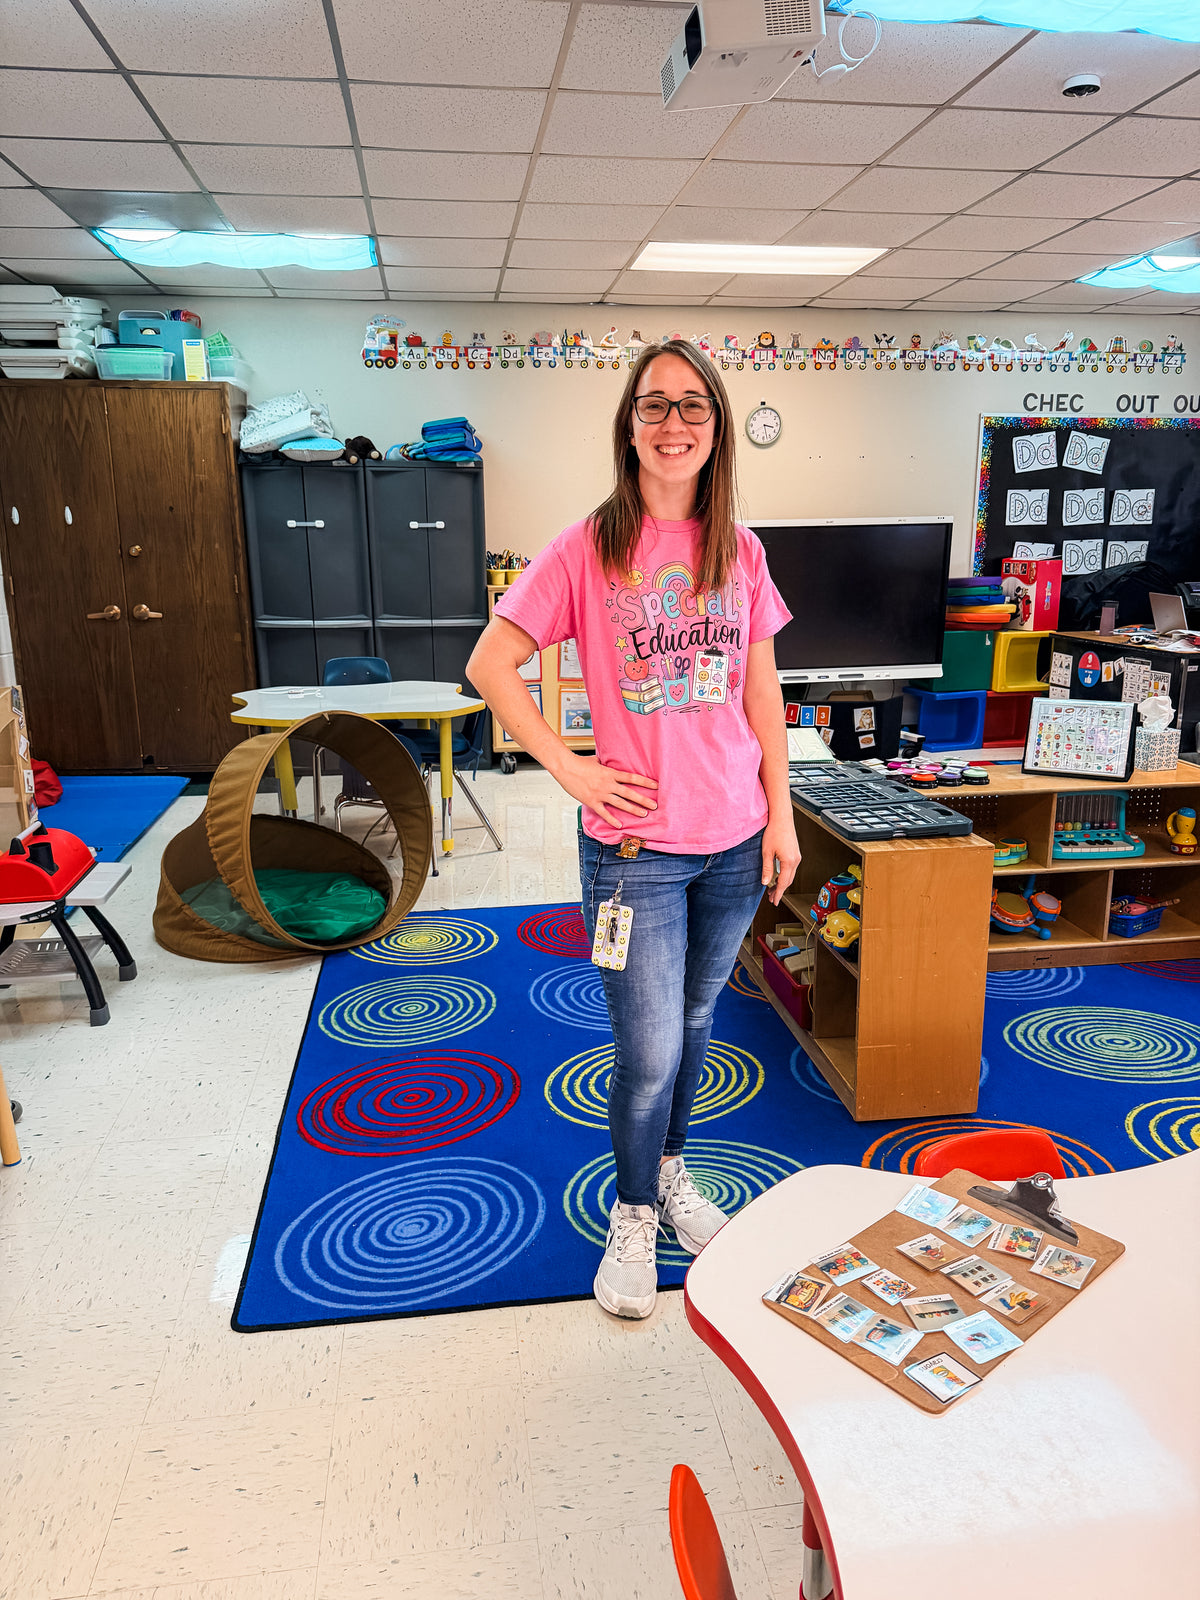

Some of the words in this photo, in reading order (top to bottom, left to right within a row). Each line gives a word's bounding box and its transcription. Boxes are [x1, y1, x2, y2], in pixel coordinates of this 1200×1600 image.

[407, 348, 421, 359] Aa
[438, 349, 453, 359] Bb
[470, 349, 484, 360] Cc
[503, 348, 518, 359] Dd
[536, 348, 550, 359] Ee
[569, 348, 582, 359] Ff
[785, 351, 803, 362] Mm
[817, 351, 832, 362] Nn
[847, 350, 862, 361] Oo
[879, 352, 892, 364] Pp
[1054, 353, 1068, 364] Vv
[1110, 353, 1123, 365] Xx
[1137, 354, 1151, 366] Yy
[1165, 355, 1178, 366] Zz
[1022, 392, 1084, 413] CHEC
[1116, 394, 1159, 413] OUT
[1173, 394, 1200, 413] OU
[1015, 434, 1057, 470] Dd
[1065, 435, 1109, 472] Dd
[1008, 492, 1048, 523] Dd
[1065, 490, 1104, 523] Dd
[1064, 542, 1103, 573] Dd
[616, 582, 740, 631] Special
[628, 616, 744, 661] Education
[1153, 673, 1169, 683] SHAPES
[920, 1358, 943, 1373] crayons
